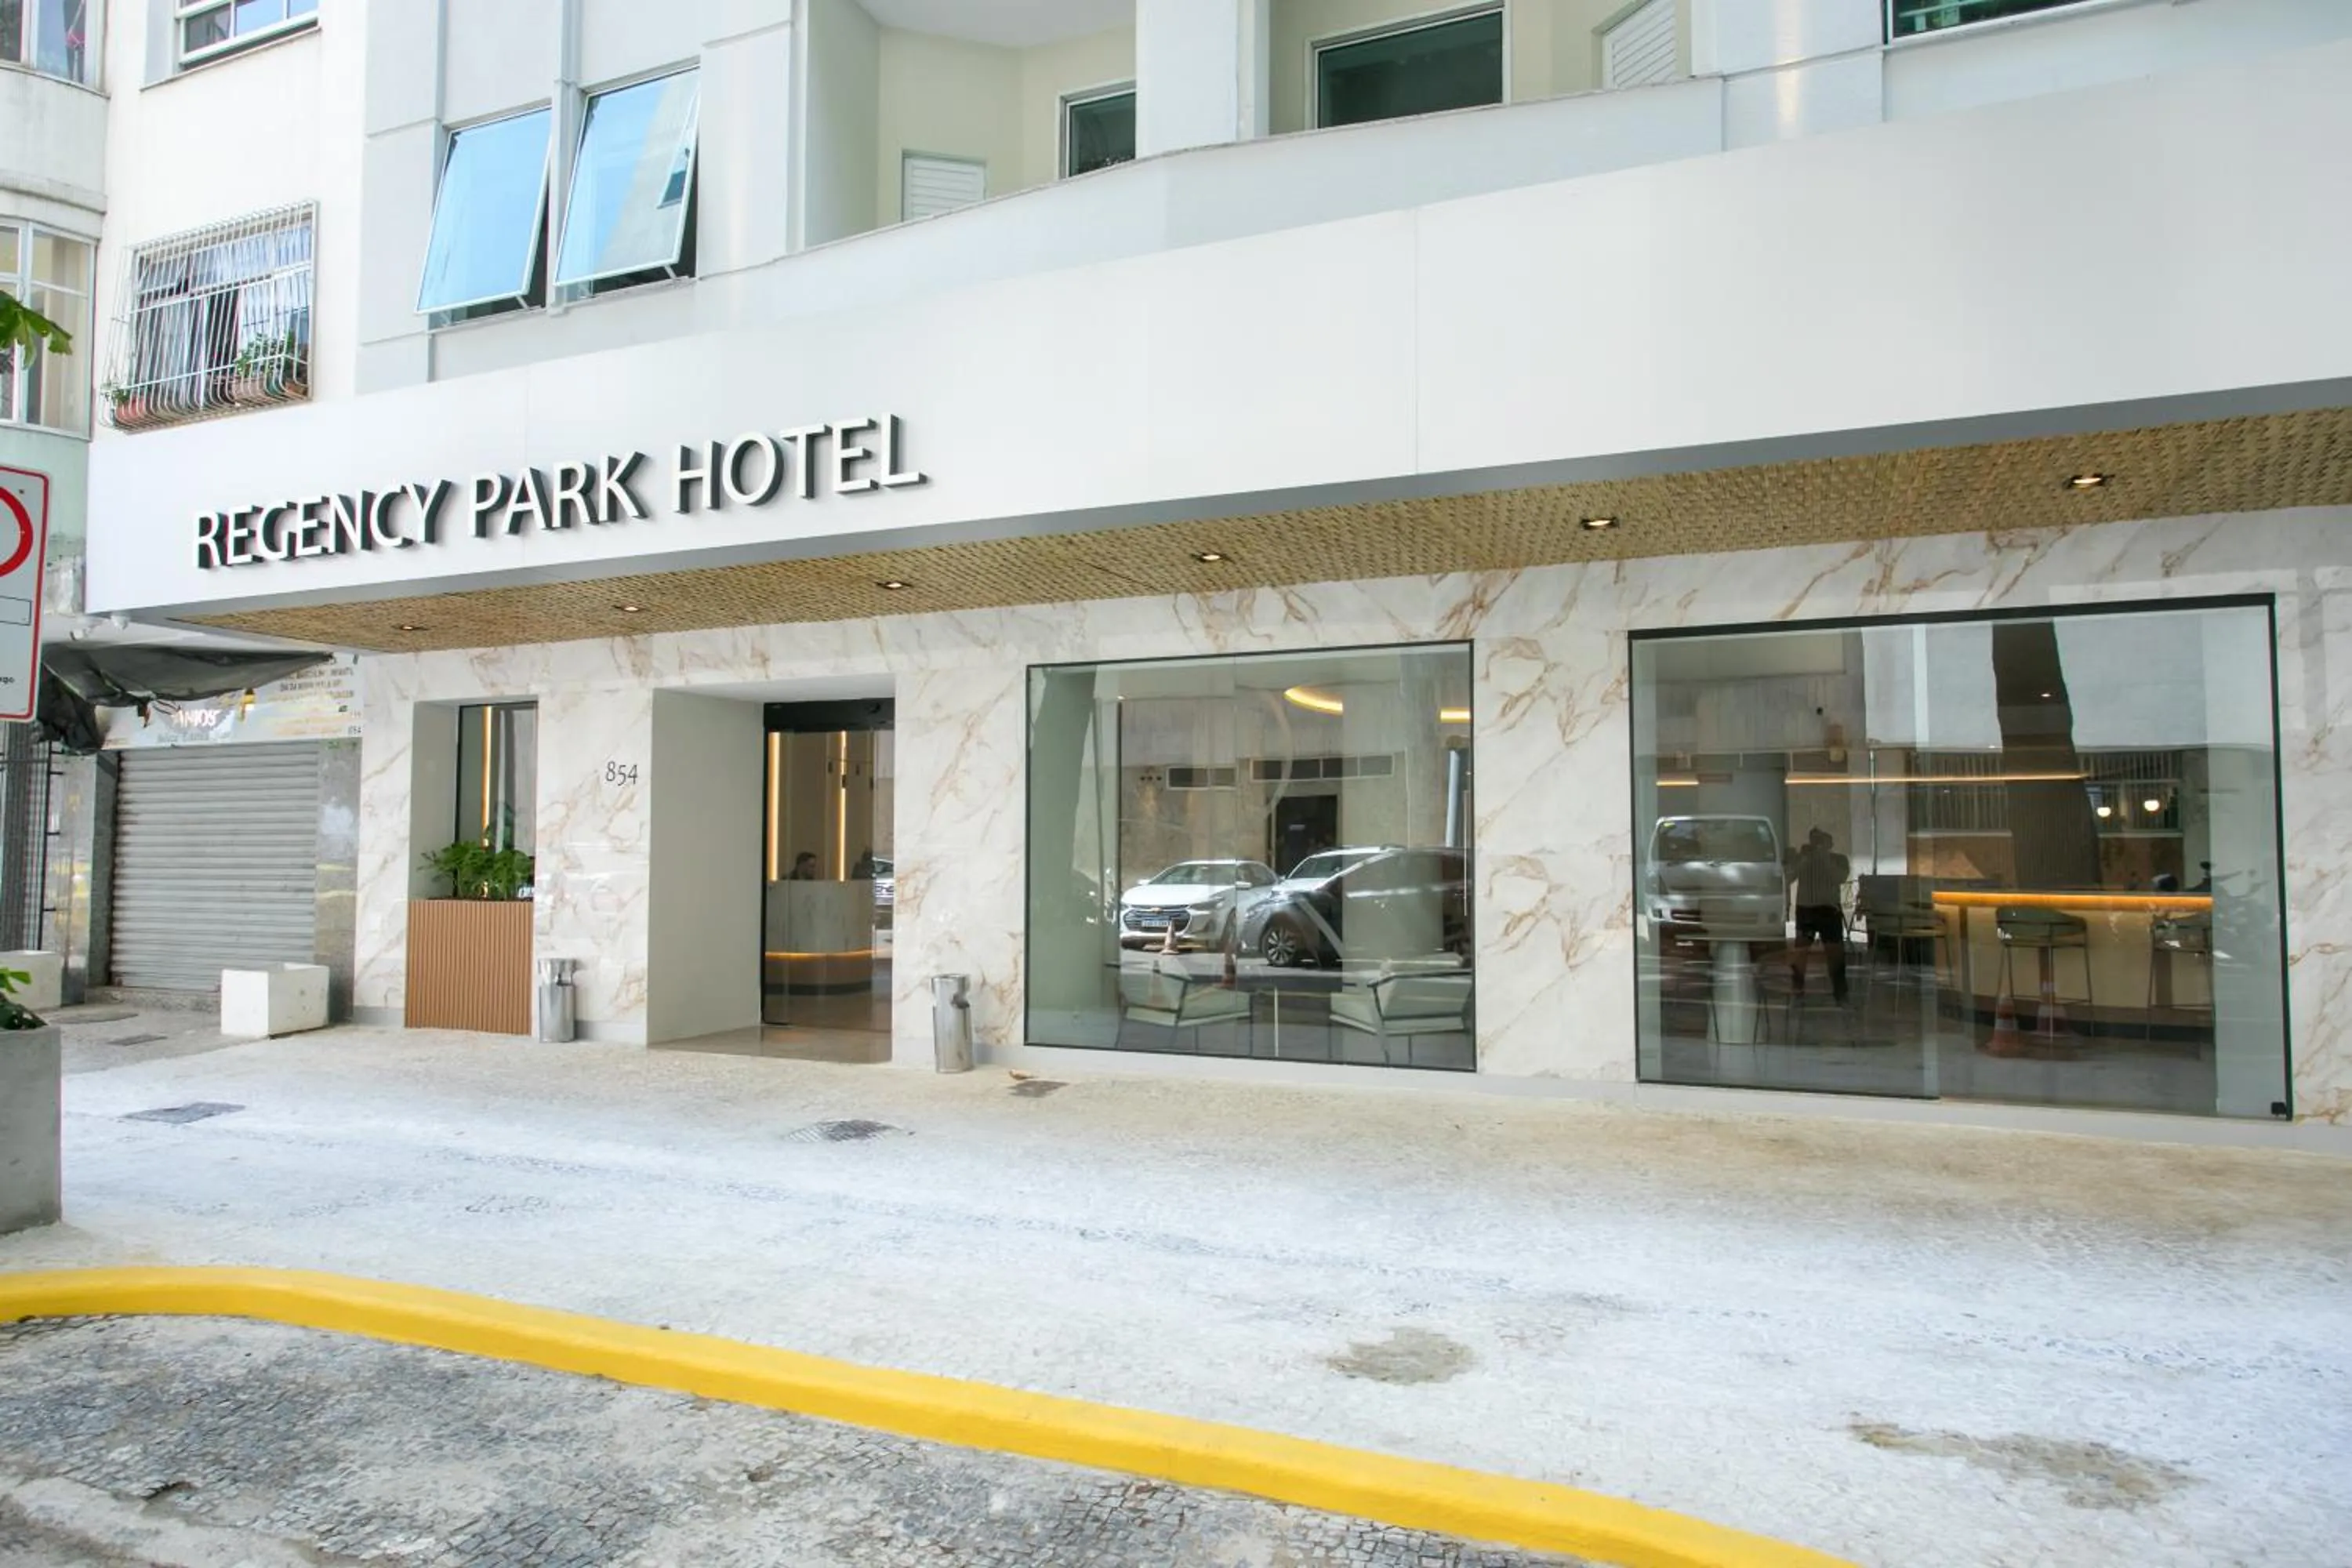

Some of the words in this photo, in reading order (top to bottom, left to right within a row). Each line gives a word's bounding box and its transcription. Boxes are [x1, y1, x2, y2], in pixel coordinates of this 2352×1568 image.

[194, 479, 452, 569] REGENCY
[469, 450, 648, 539] PARK
[672, 412, 928, 514] HOTEL
[605, 760, 637, 786] 854
